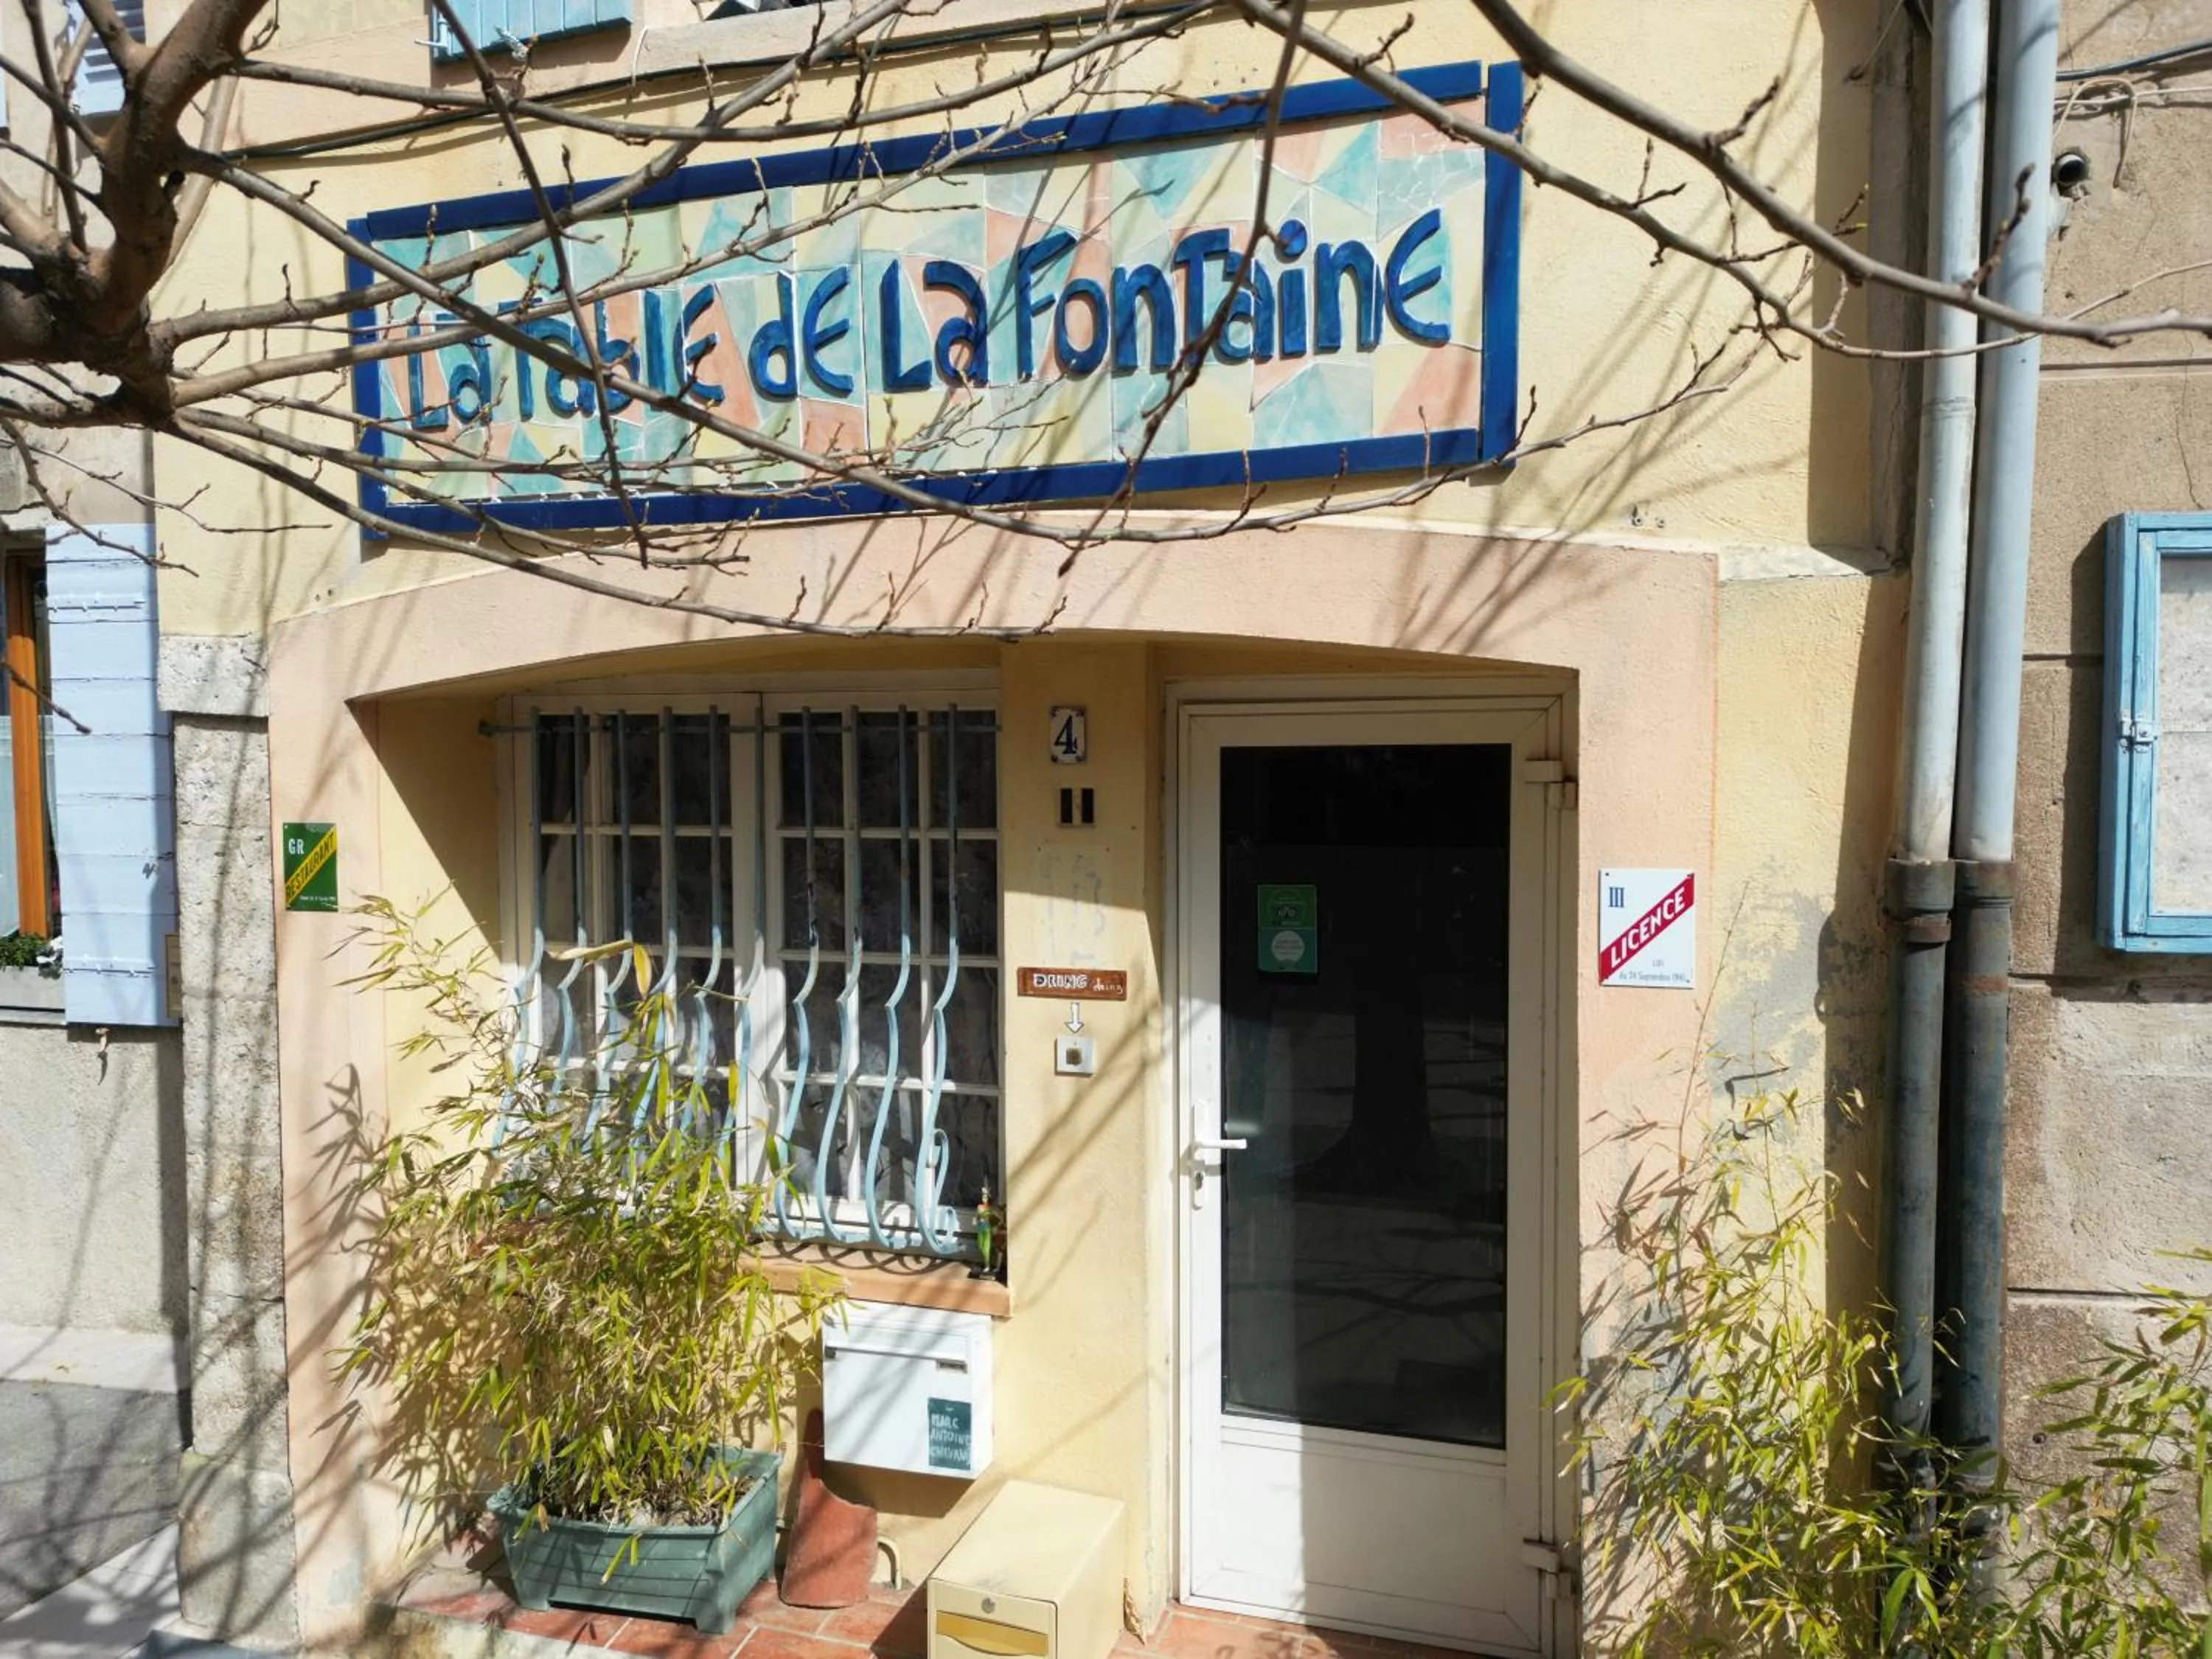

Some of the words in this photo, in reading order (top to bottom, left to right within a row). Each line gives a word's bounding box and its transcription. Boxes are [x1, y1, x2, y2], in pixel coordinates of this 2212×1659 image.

[882, 257, 989, 392] La
[1054, 714, 1077, 755] 4
[288, 838, 305, 855] GR
[285, 829, 336, 902] RESTAURANT
[1608, 887, 1625, 908] III
[1610, 886, 1686, 969] LICENCE
[1033, 973, 1088, 989] DRING
[931, 1413, 959, 1429] MARC
